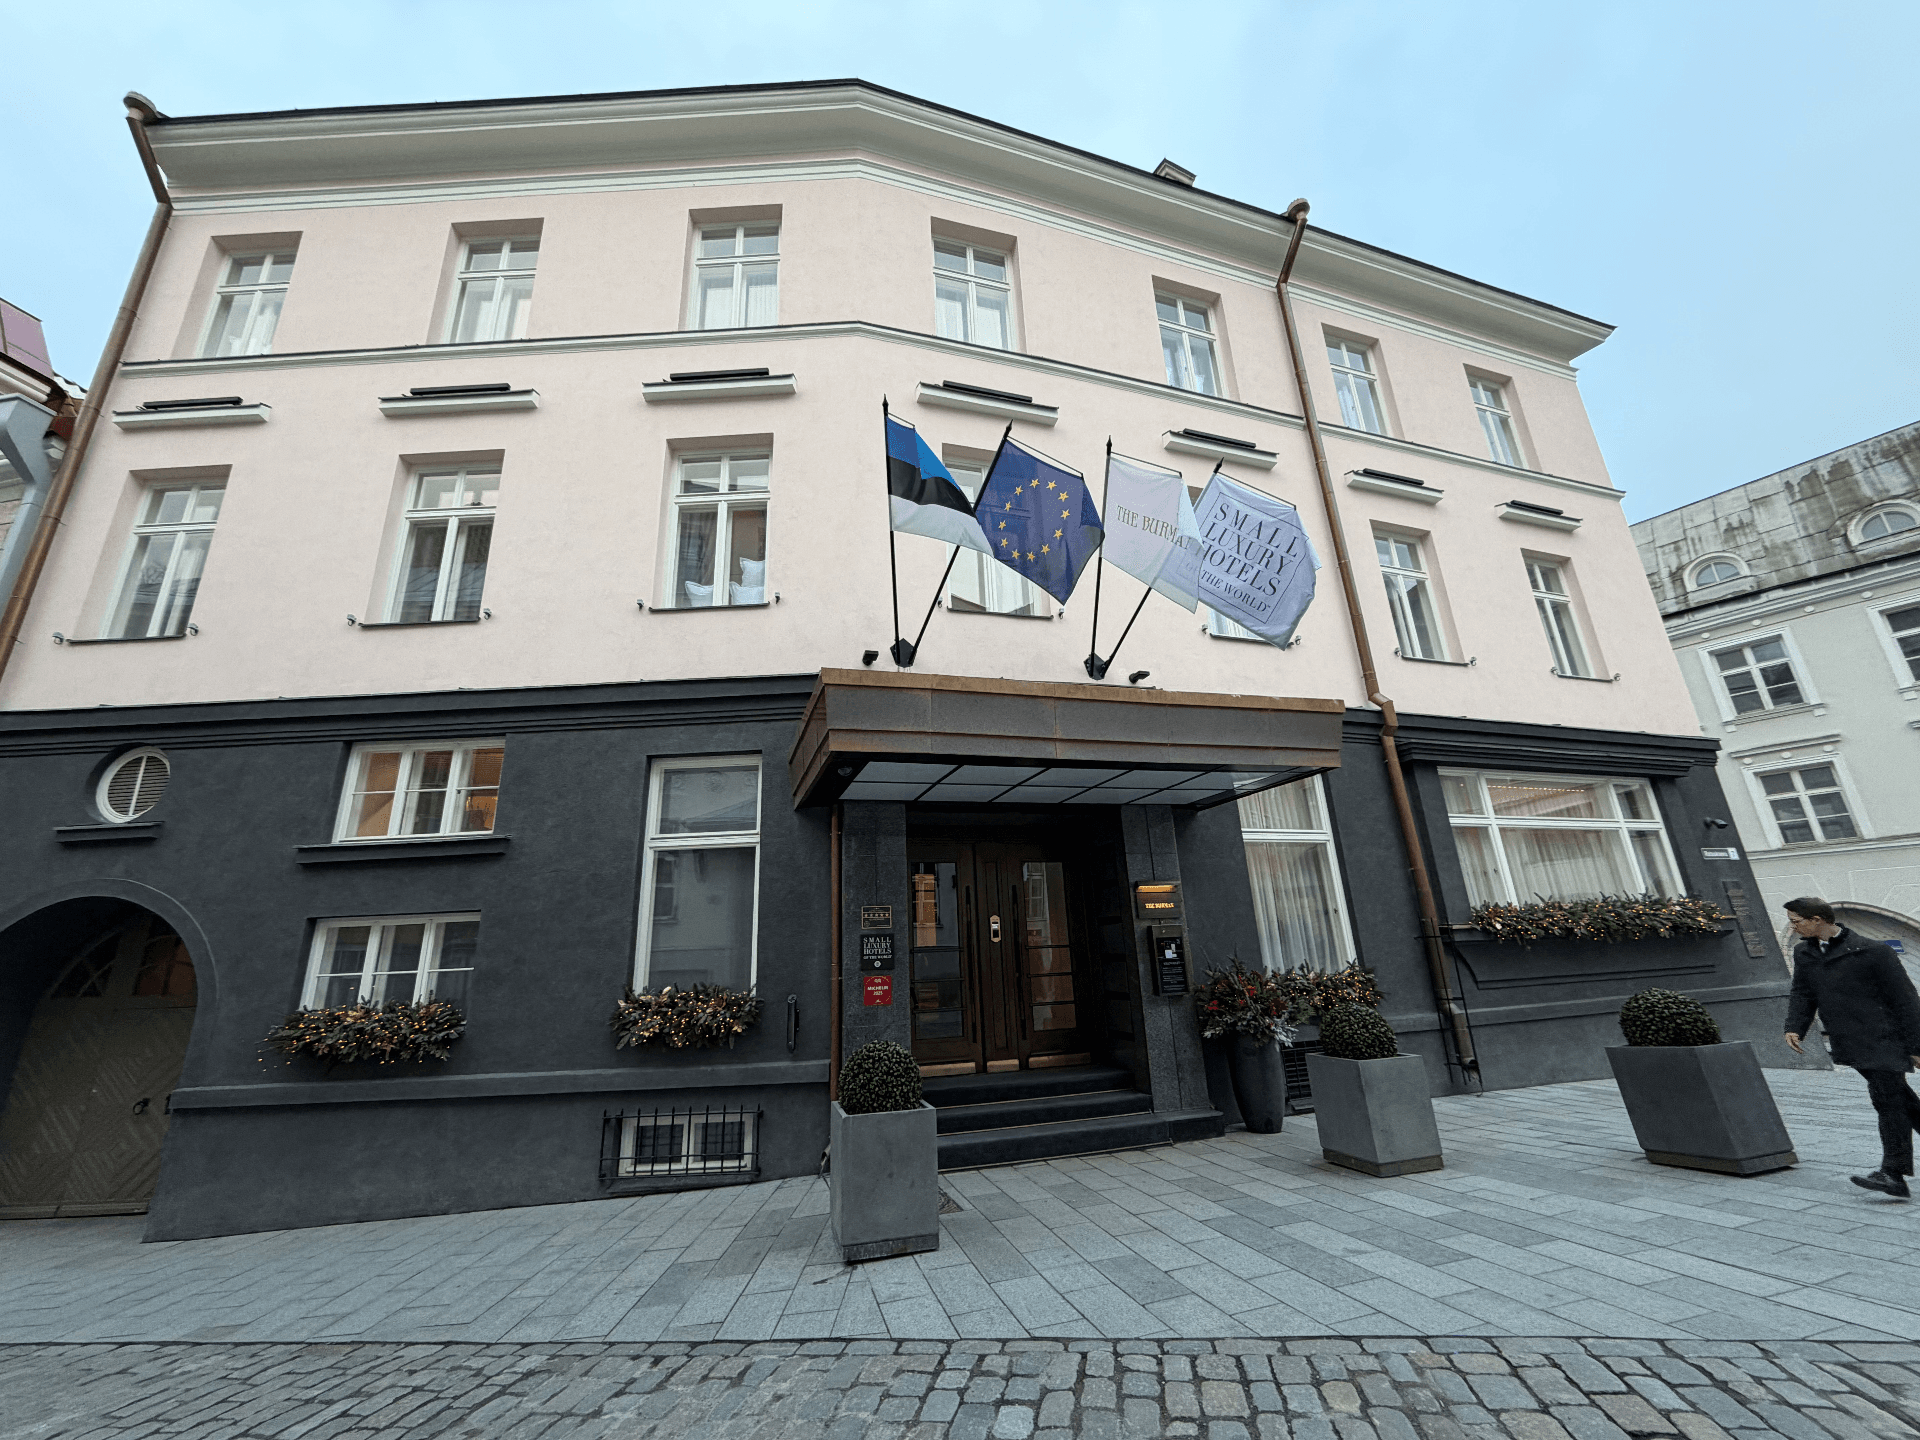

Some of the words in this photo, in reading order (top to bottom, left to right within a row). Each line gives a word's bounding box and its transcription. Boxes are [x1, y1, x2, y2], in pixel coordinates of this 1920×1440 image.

[1117, 504, 1139, 528] THE
[1214, 503, 1299, 557] SMALL
[1203, 521, 1294, 577] LUXURY
[1201, 569, 1224, 589] THE
[1224, 582, 1267, 612] WORLD
